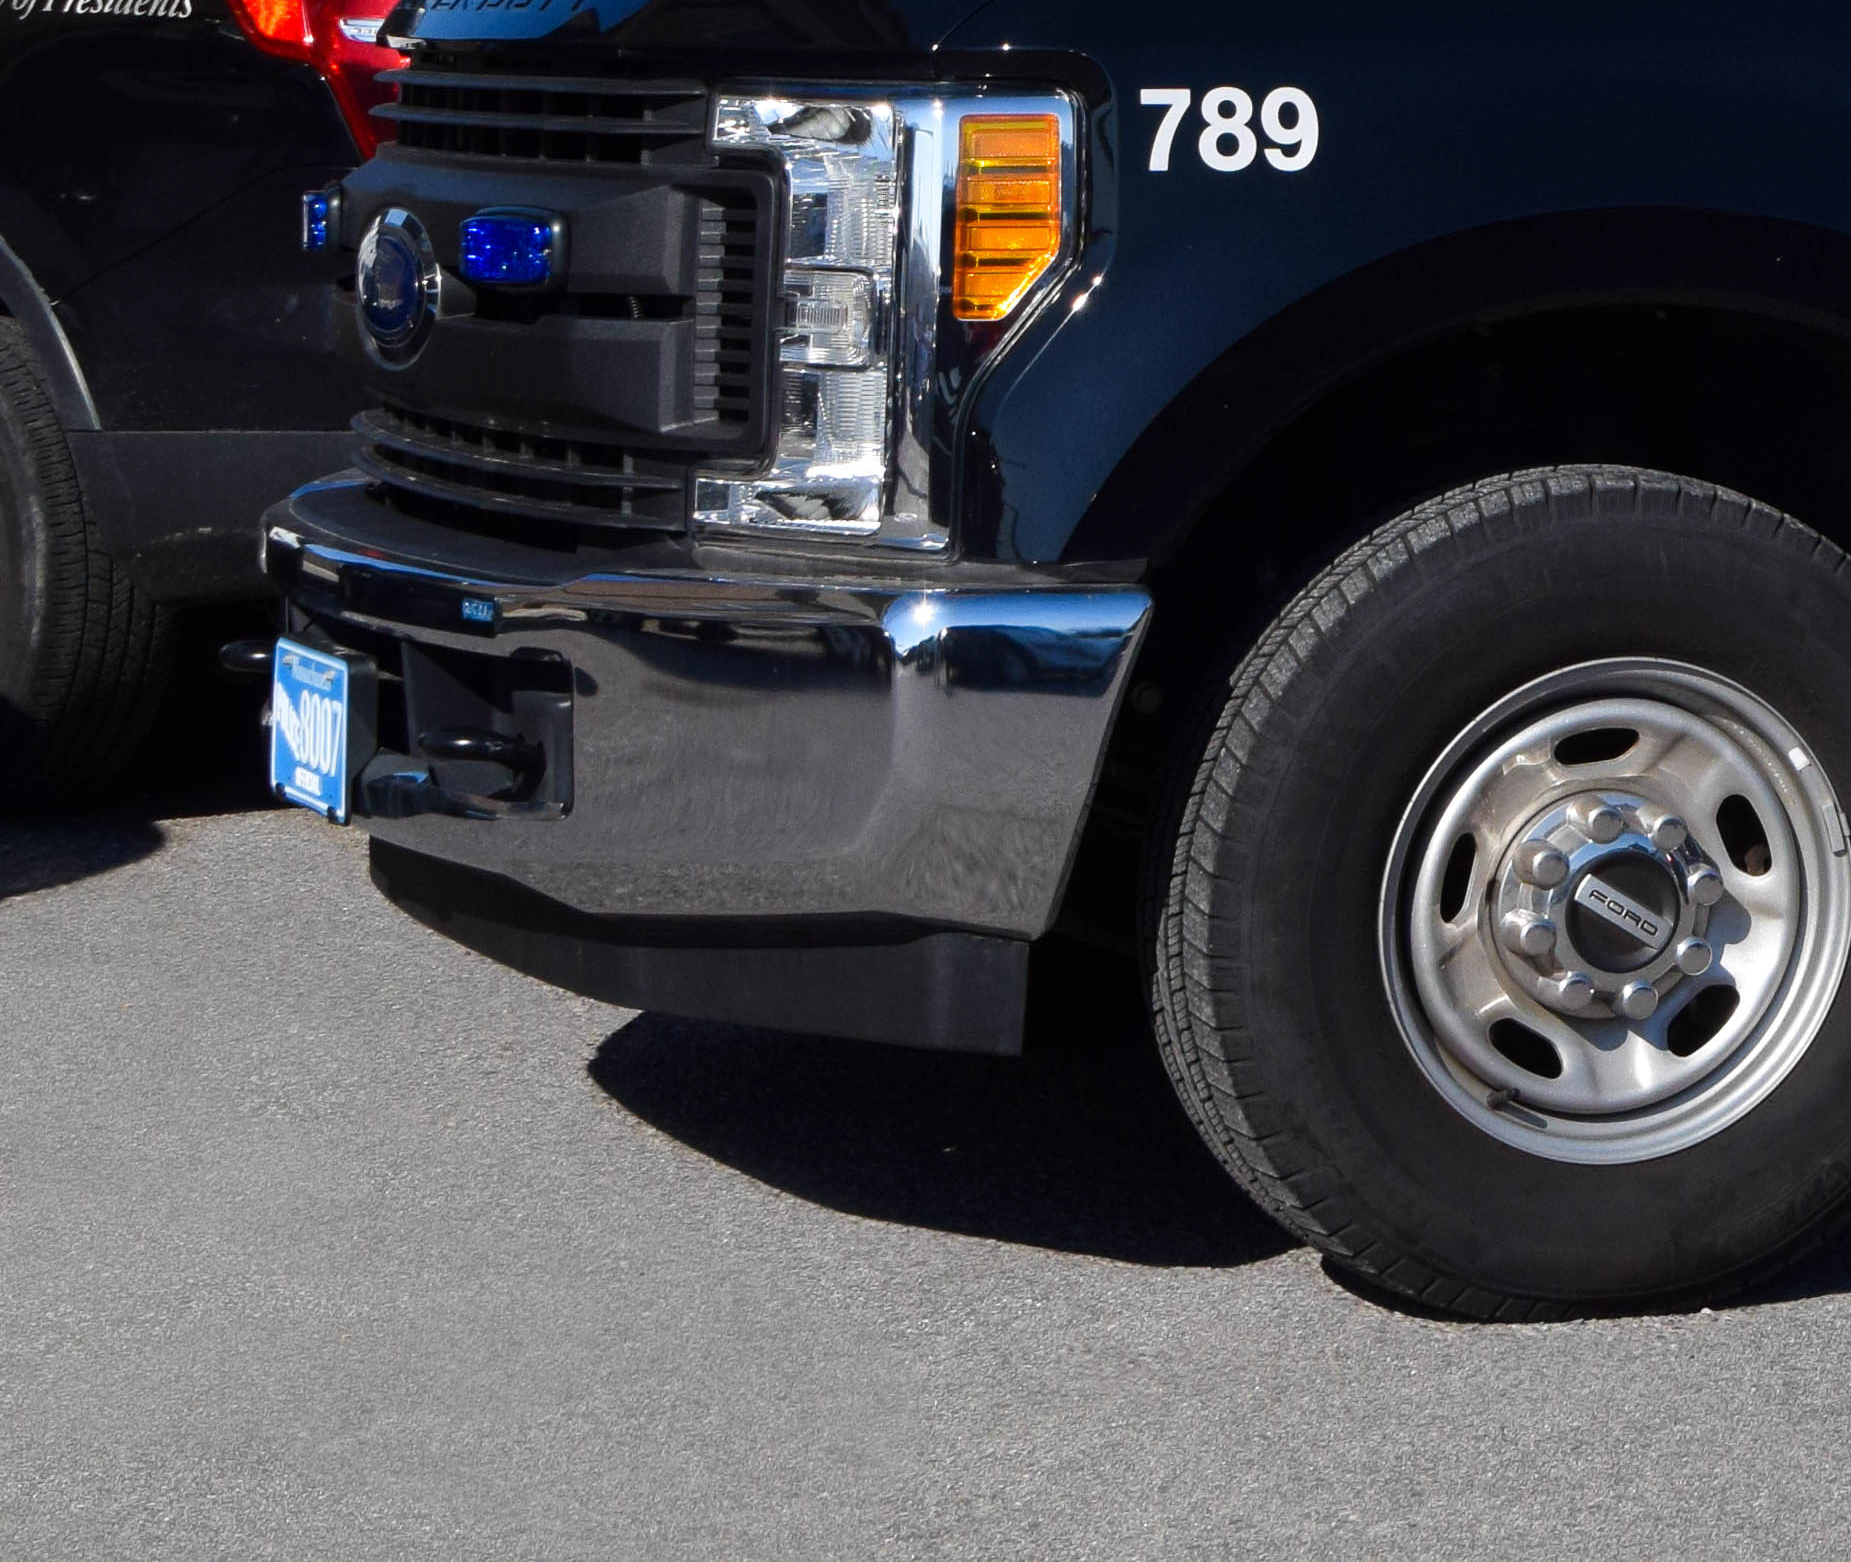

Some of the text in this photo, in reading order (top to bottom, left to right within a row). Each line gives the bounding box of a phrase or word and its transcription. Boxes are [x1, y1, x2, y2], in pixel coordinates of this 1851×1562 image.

[1140, 86, 1320, 173] 789
[299, 688, 343, 777] 8007
[1588, 889, 1659, 936] FORD
